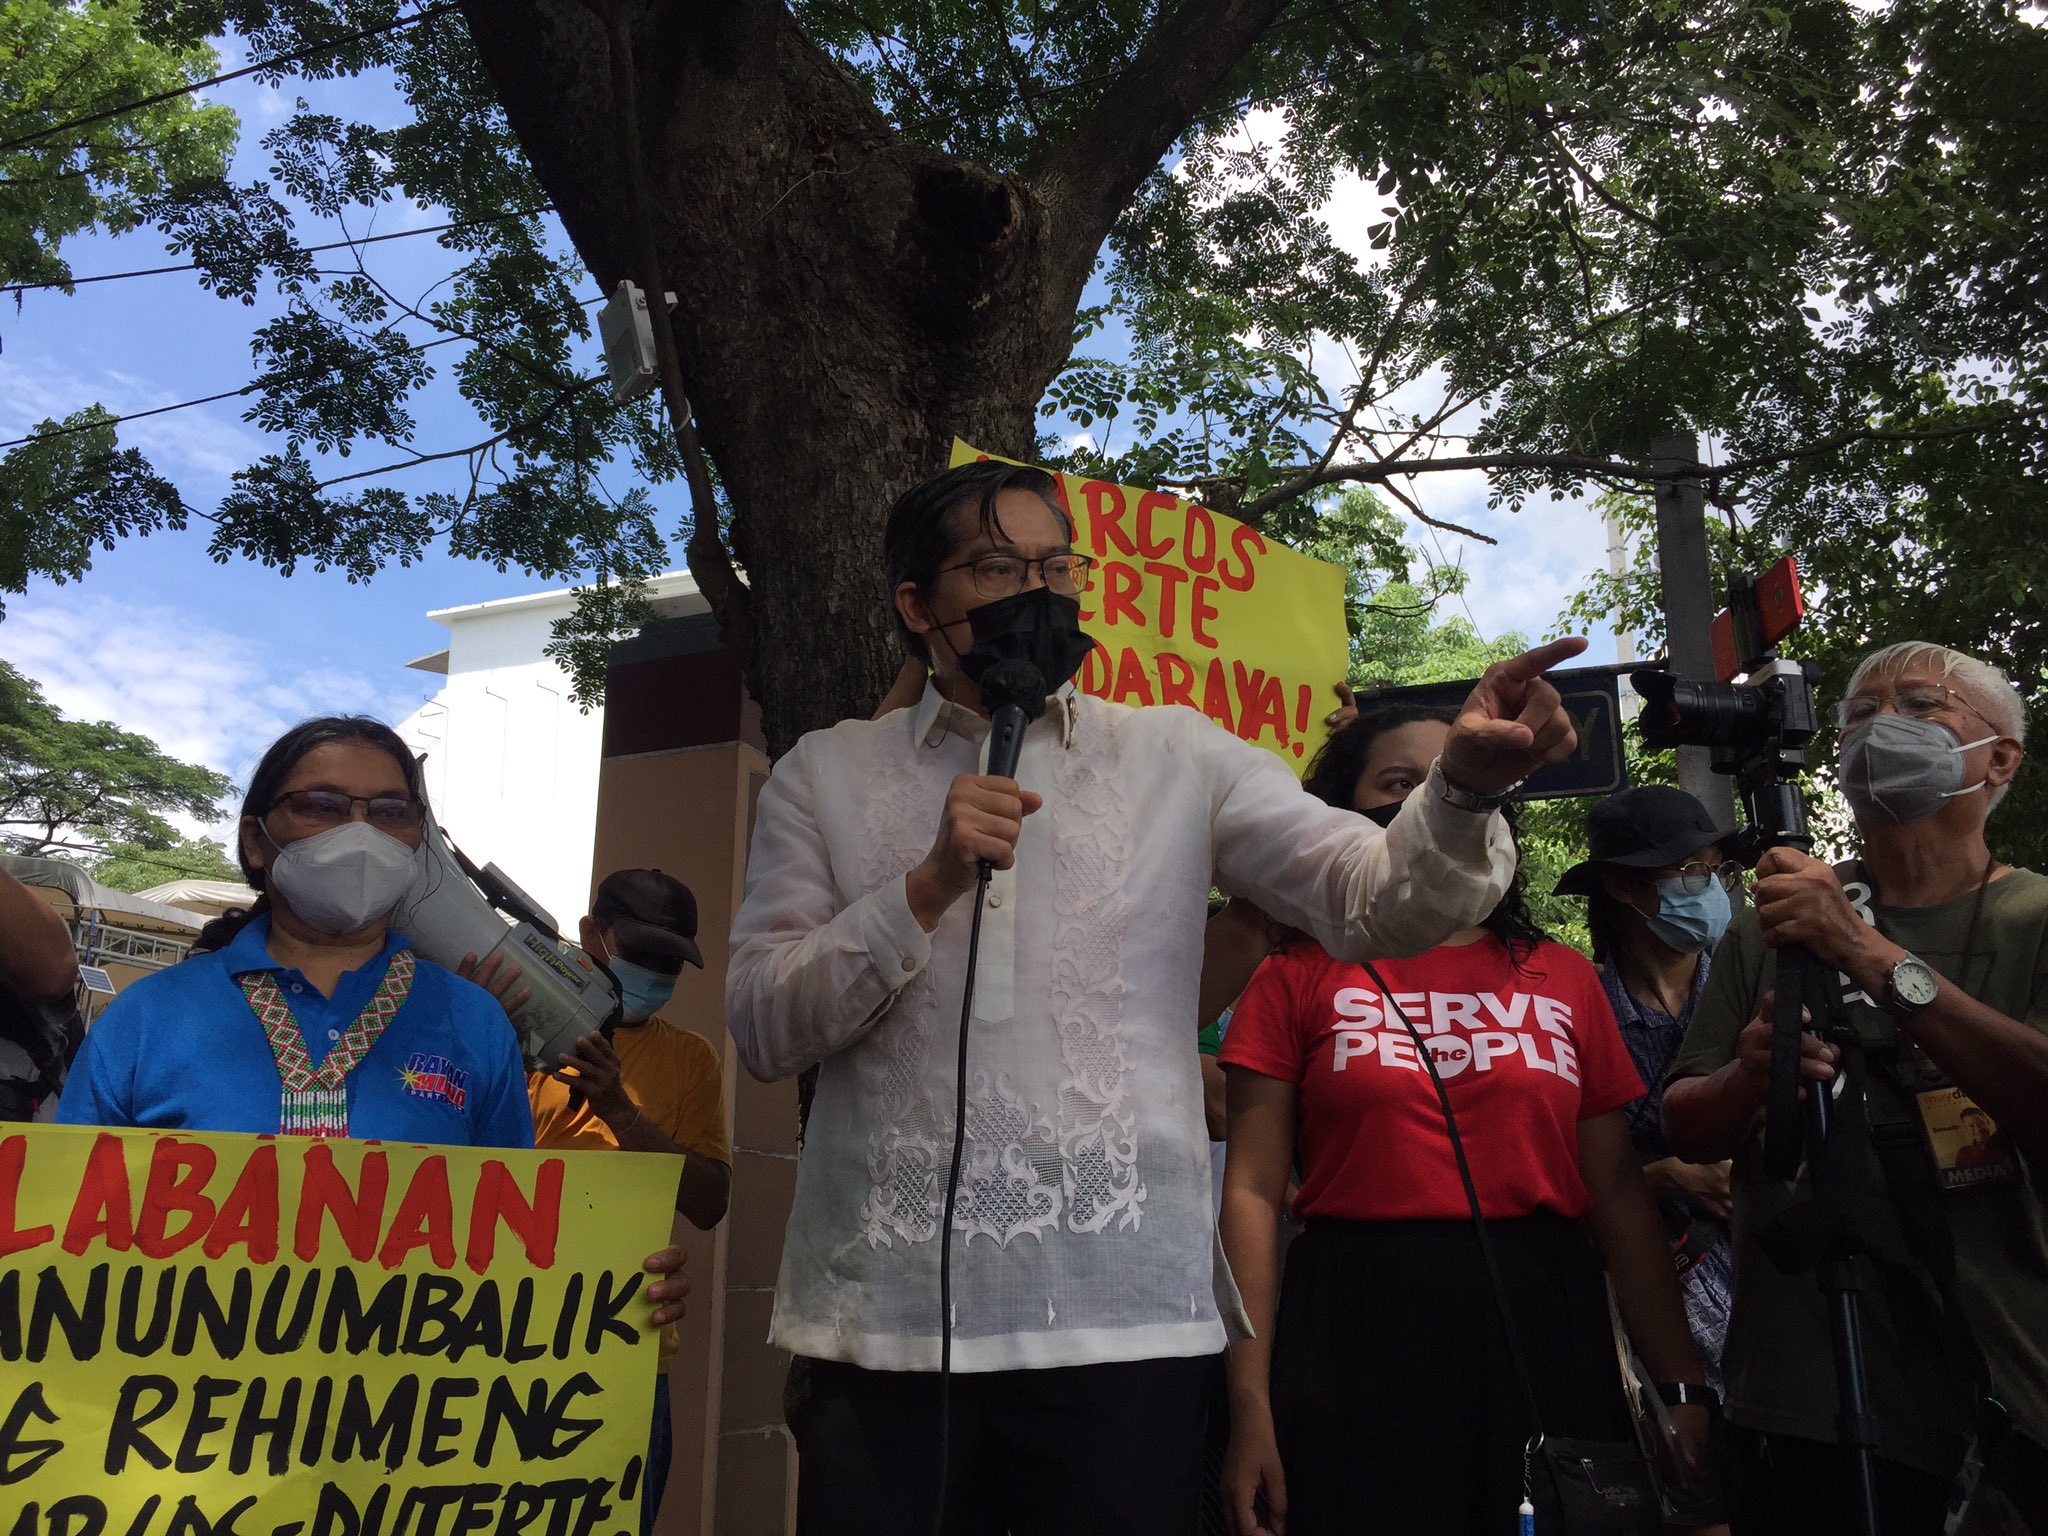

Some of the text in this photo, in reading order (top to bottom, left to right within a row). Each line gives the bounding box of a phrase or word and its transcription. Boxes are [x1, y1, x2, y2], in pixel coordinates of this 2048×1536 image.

[1331, 987, 1574, 1040] SERVE
[1428, 1047, 1467, 1063] he
[0, 1132, 564, 1275] LABANAN
[104, 1372, 604, 1476] REHIMENG
